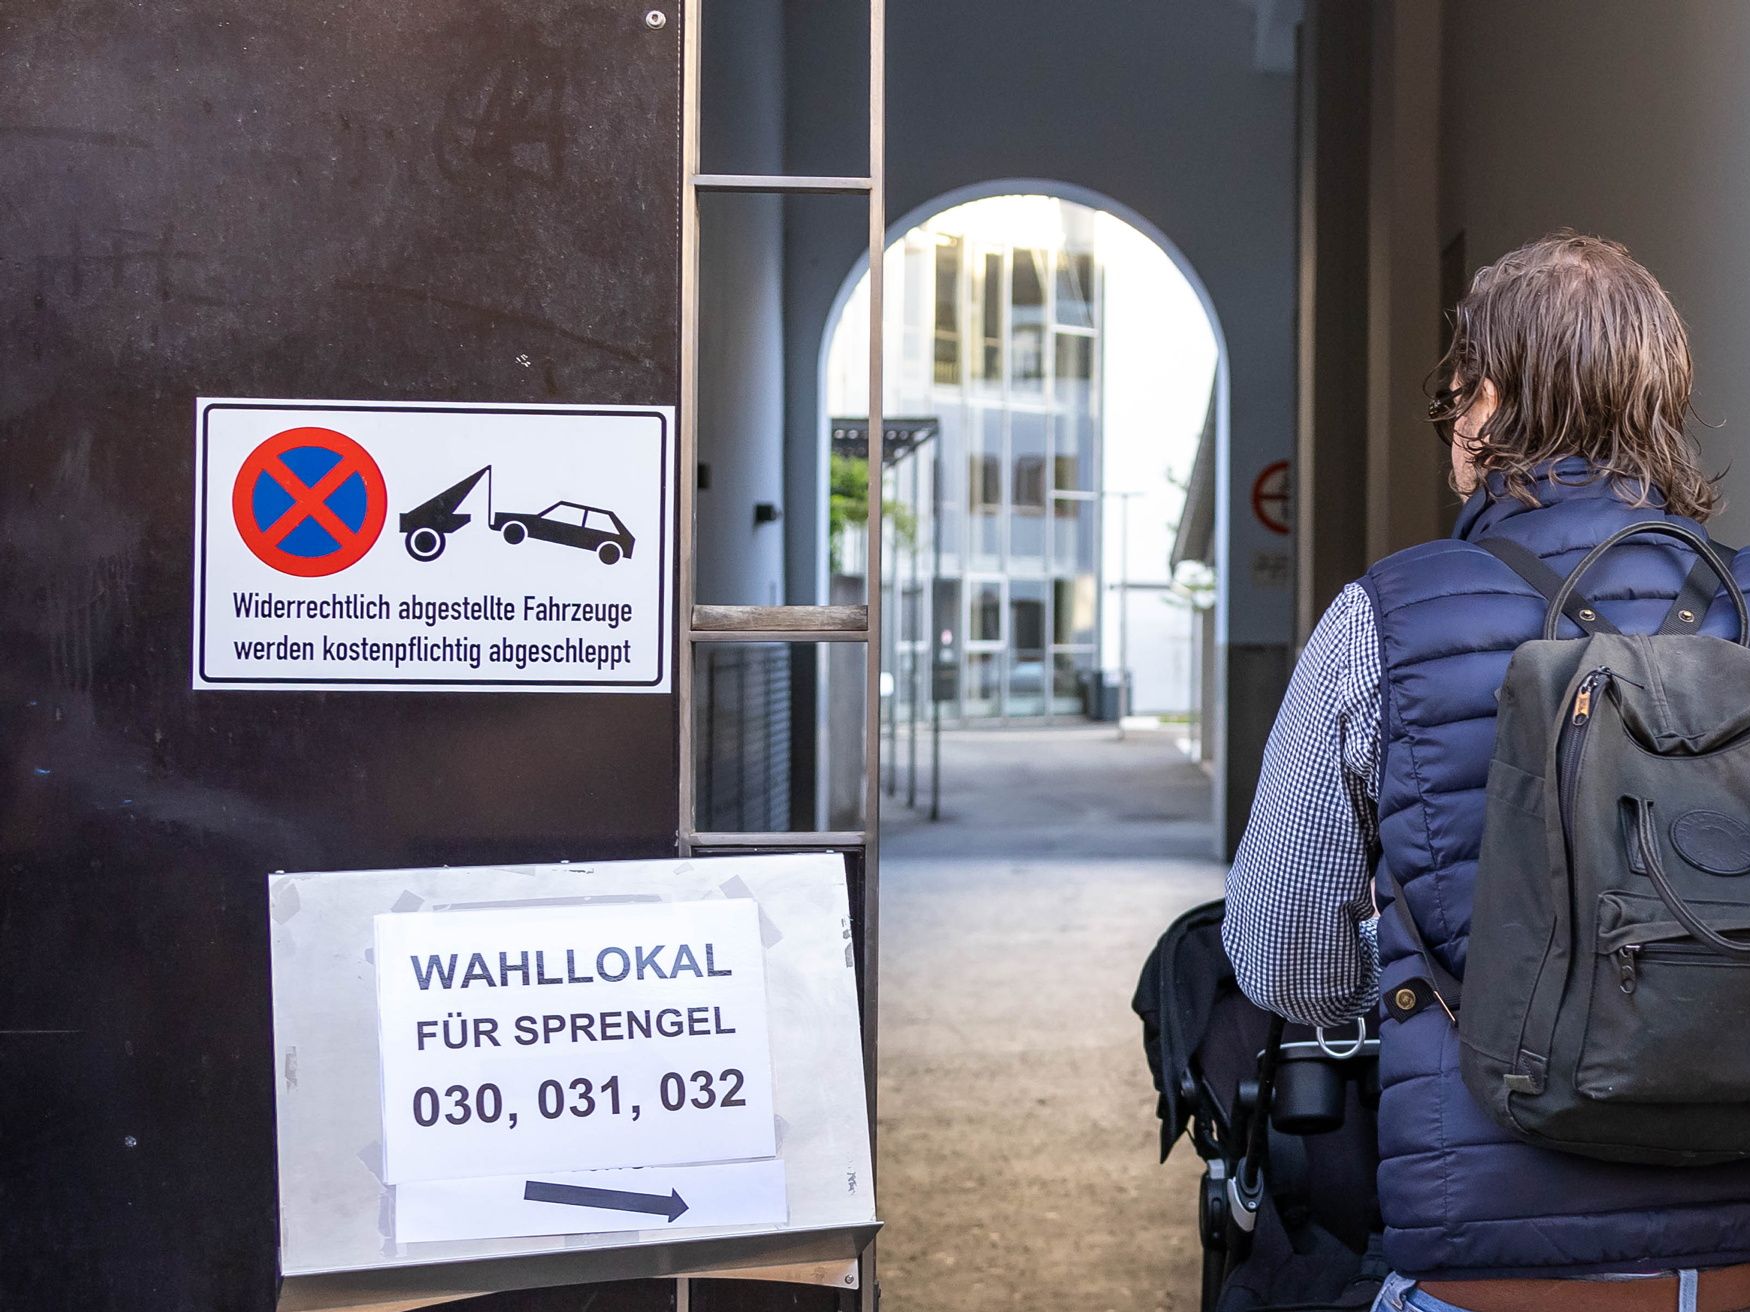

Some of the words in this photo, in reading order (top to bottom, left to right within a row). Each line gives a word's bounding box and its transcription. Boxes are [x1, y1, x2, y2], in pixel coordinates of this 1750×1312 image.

[233, 592, 391, 621] Widerrechtlich
[398, 595, 516, 627] abgestellte
[523, 596, 633, 628] Fahrzeuge
[234, 636, 314, 661] werden
[323, 636, 481, 669] kostenpflichtig
[489, 638, 632, 670] abgeschleppt
[411, 943, 732, 991] WAHLLOKAL
[416, 1012, 502, 1051] FÜR
[514, 1006, 736, 1046] SPRENGEL
[412, 1083, 518, 1130] 030,
[537, 1075, 641, 1122] 031,
[660, 1068, 746, 1112] 032
